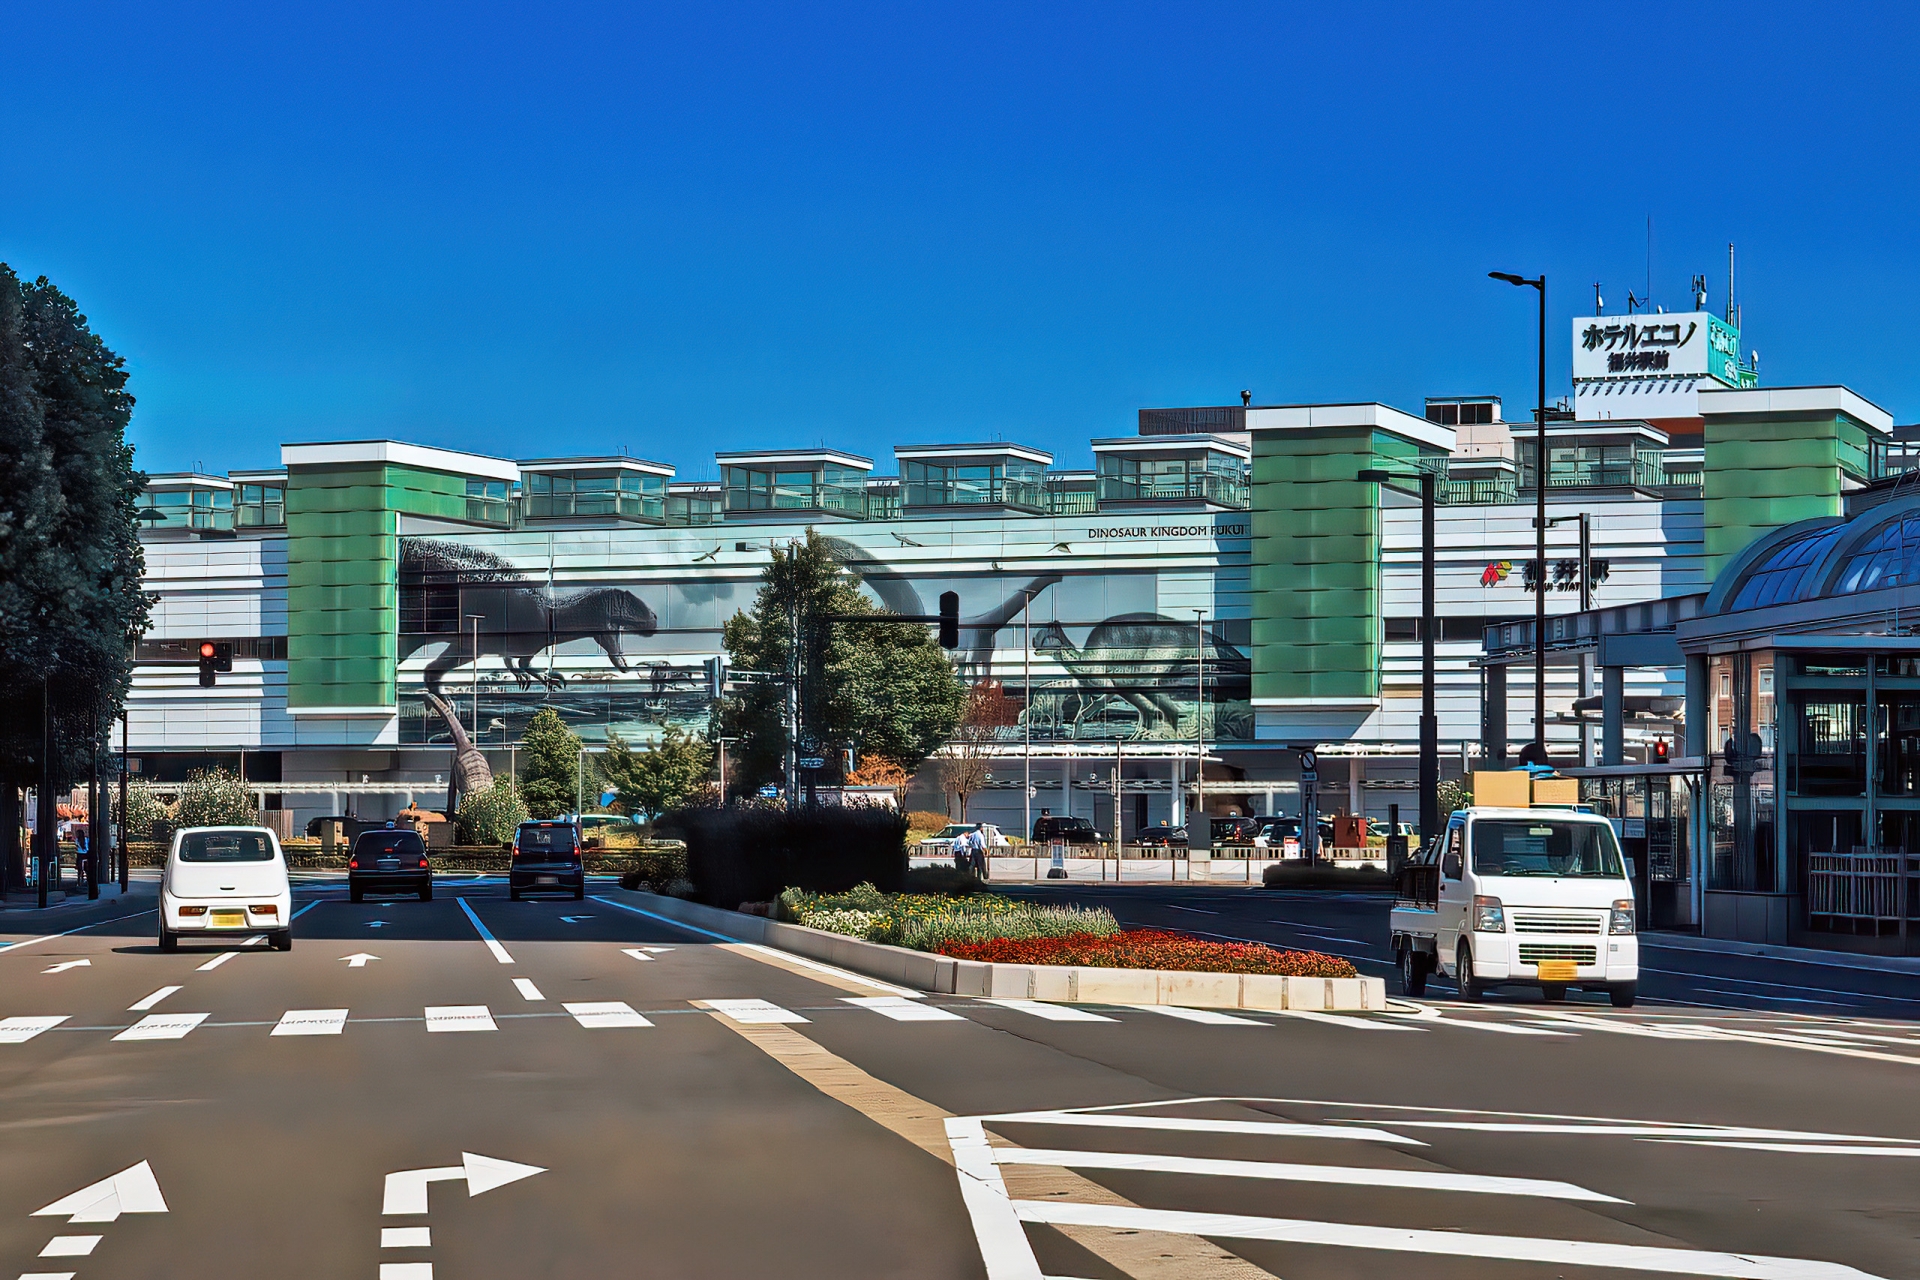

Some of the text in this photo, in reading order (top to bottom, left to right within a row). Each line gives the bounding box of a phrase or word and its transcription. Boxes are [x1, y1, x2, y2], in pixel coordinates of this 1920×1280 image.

[1582, 321, 1697, 351] ホテルエコノ
[1088, 524, 1245, 538] DINOSAUR KINGDOM FUKUI
